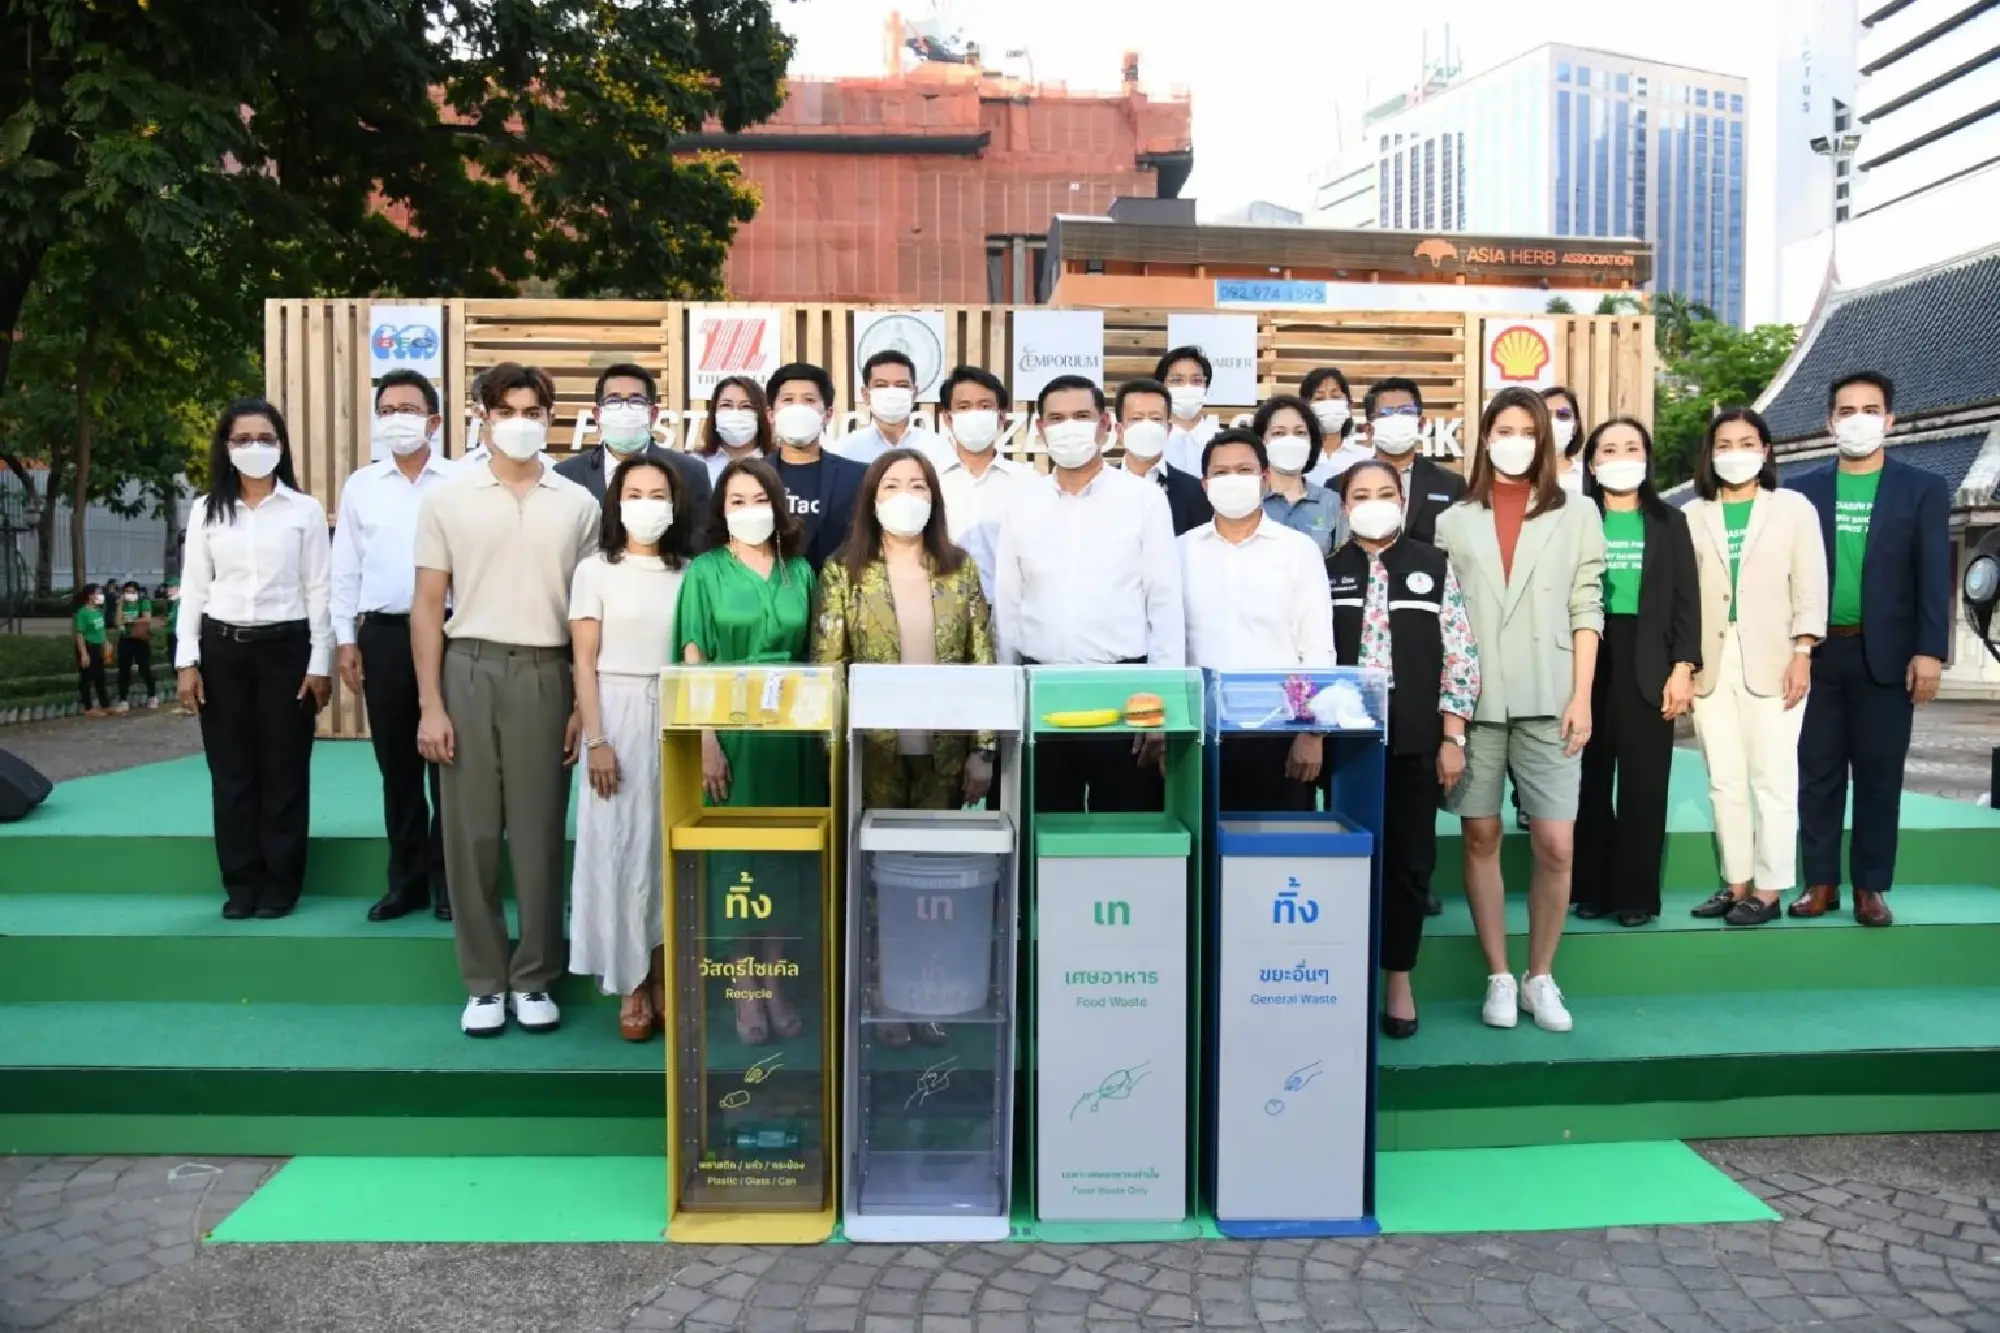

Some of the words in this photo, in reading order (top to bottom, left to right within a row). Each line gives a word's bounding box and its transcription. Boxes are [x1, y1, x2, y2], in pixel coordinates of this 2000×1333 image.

[1466, 246, 1505, 264] ASIA
[1511, 248, 1557, 265] HERB
[1561, 252, 1634, 267] ASSOCIATION
[725, 871, 773, 919] ทิ้ง
[1273, 876, 1320, 924] ทิ้ง
[916, 895, 953, 920] เท
[1094, 901, 1131, 926] เท
[1064, 971, 1159, 985] เศษอาหาร
[725, 987, 773, 1001] Recycle
[1076, 996, 1106, 1008] Food
[1109, 996, 1148, 1008] Waste
[1250, 993, 1298, 1005] General
[1300, 994, 1338, 1005] Waste
